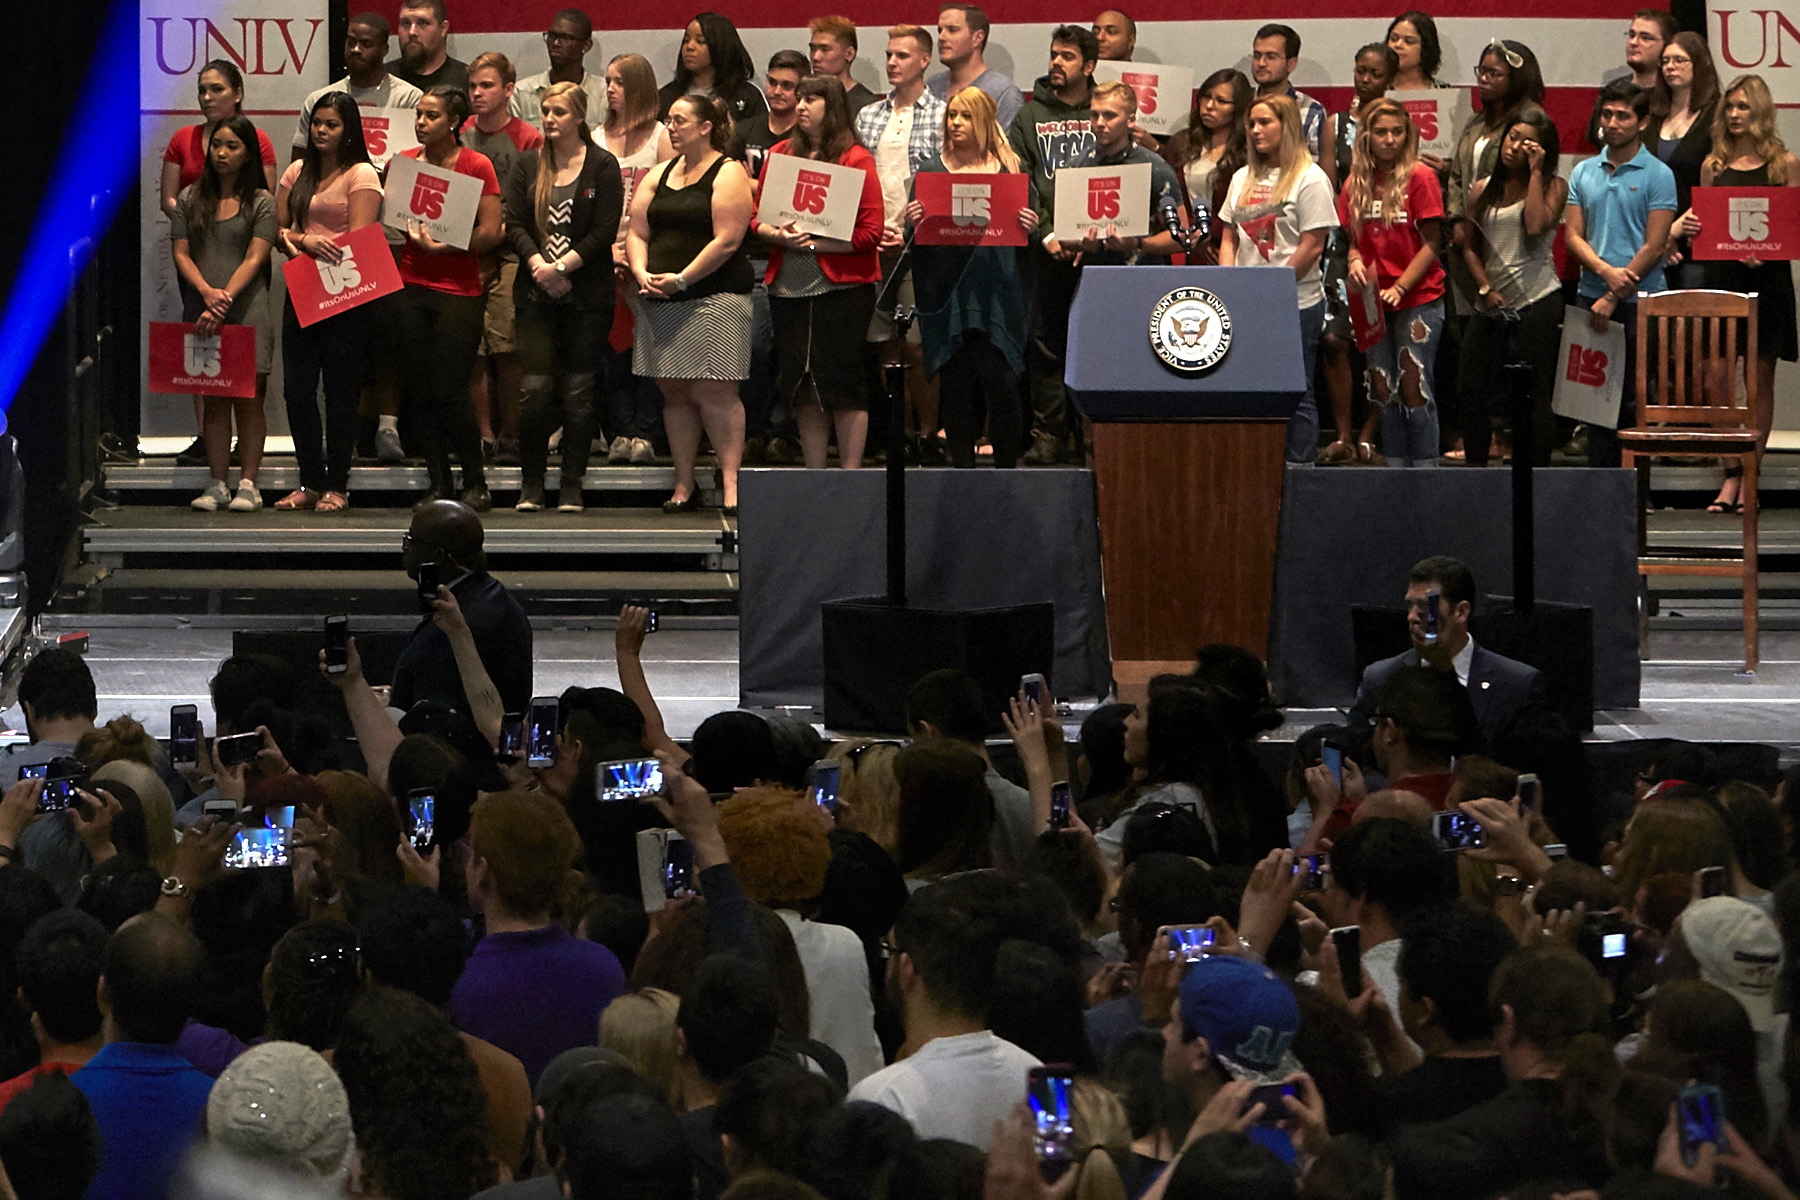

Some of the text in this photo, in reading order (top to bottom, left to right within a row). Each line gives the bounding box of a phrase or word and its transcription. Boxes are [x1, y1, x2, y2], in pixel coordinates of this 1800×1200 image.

[146, 17, 325, 75] UNLV
[1105, 179, 1116, 188] ON
[410, 184, 445, 220] US
[792, 183, 828, 215] US
[951, 197, 991, 227] US
[1087, 190, 1120, 220] US
[939, 227, 1004, 237] #ItsOnUsUNLV
[1729, 211, 1769, 241] US
[318, 259, 362, 295] US
[318, 281, 378, 310] #ItsOnUsUNLV
[1150, 290, 1231, 366] VICE PRESIDENT OF THE UNITED STATES
[184, 348, 221, 377] US
[1577, 347, 1609, 388] US
[172, 377, 232, 387] #ItsOnUsUNLV
